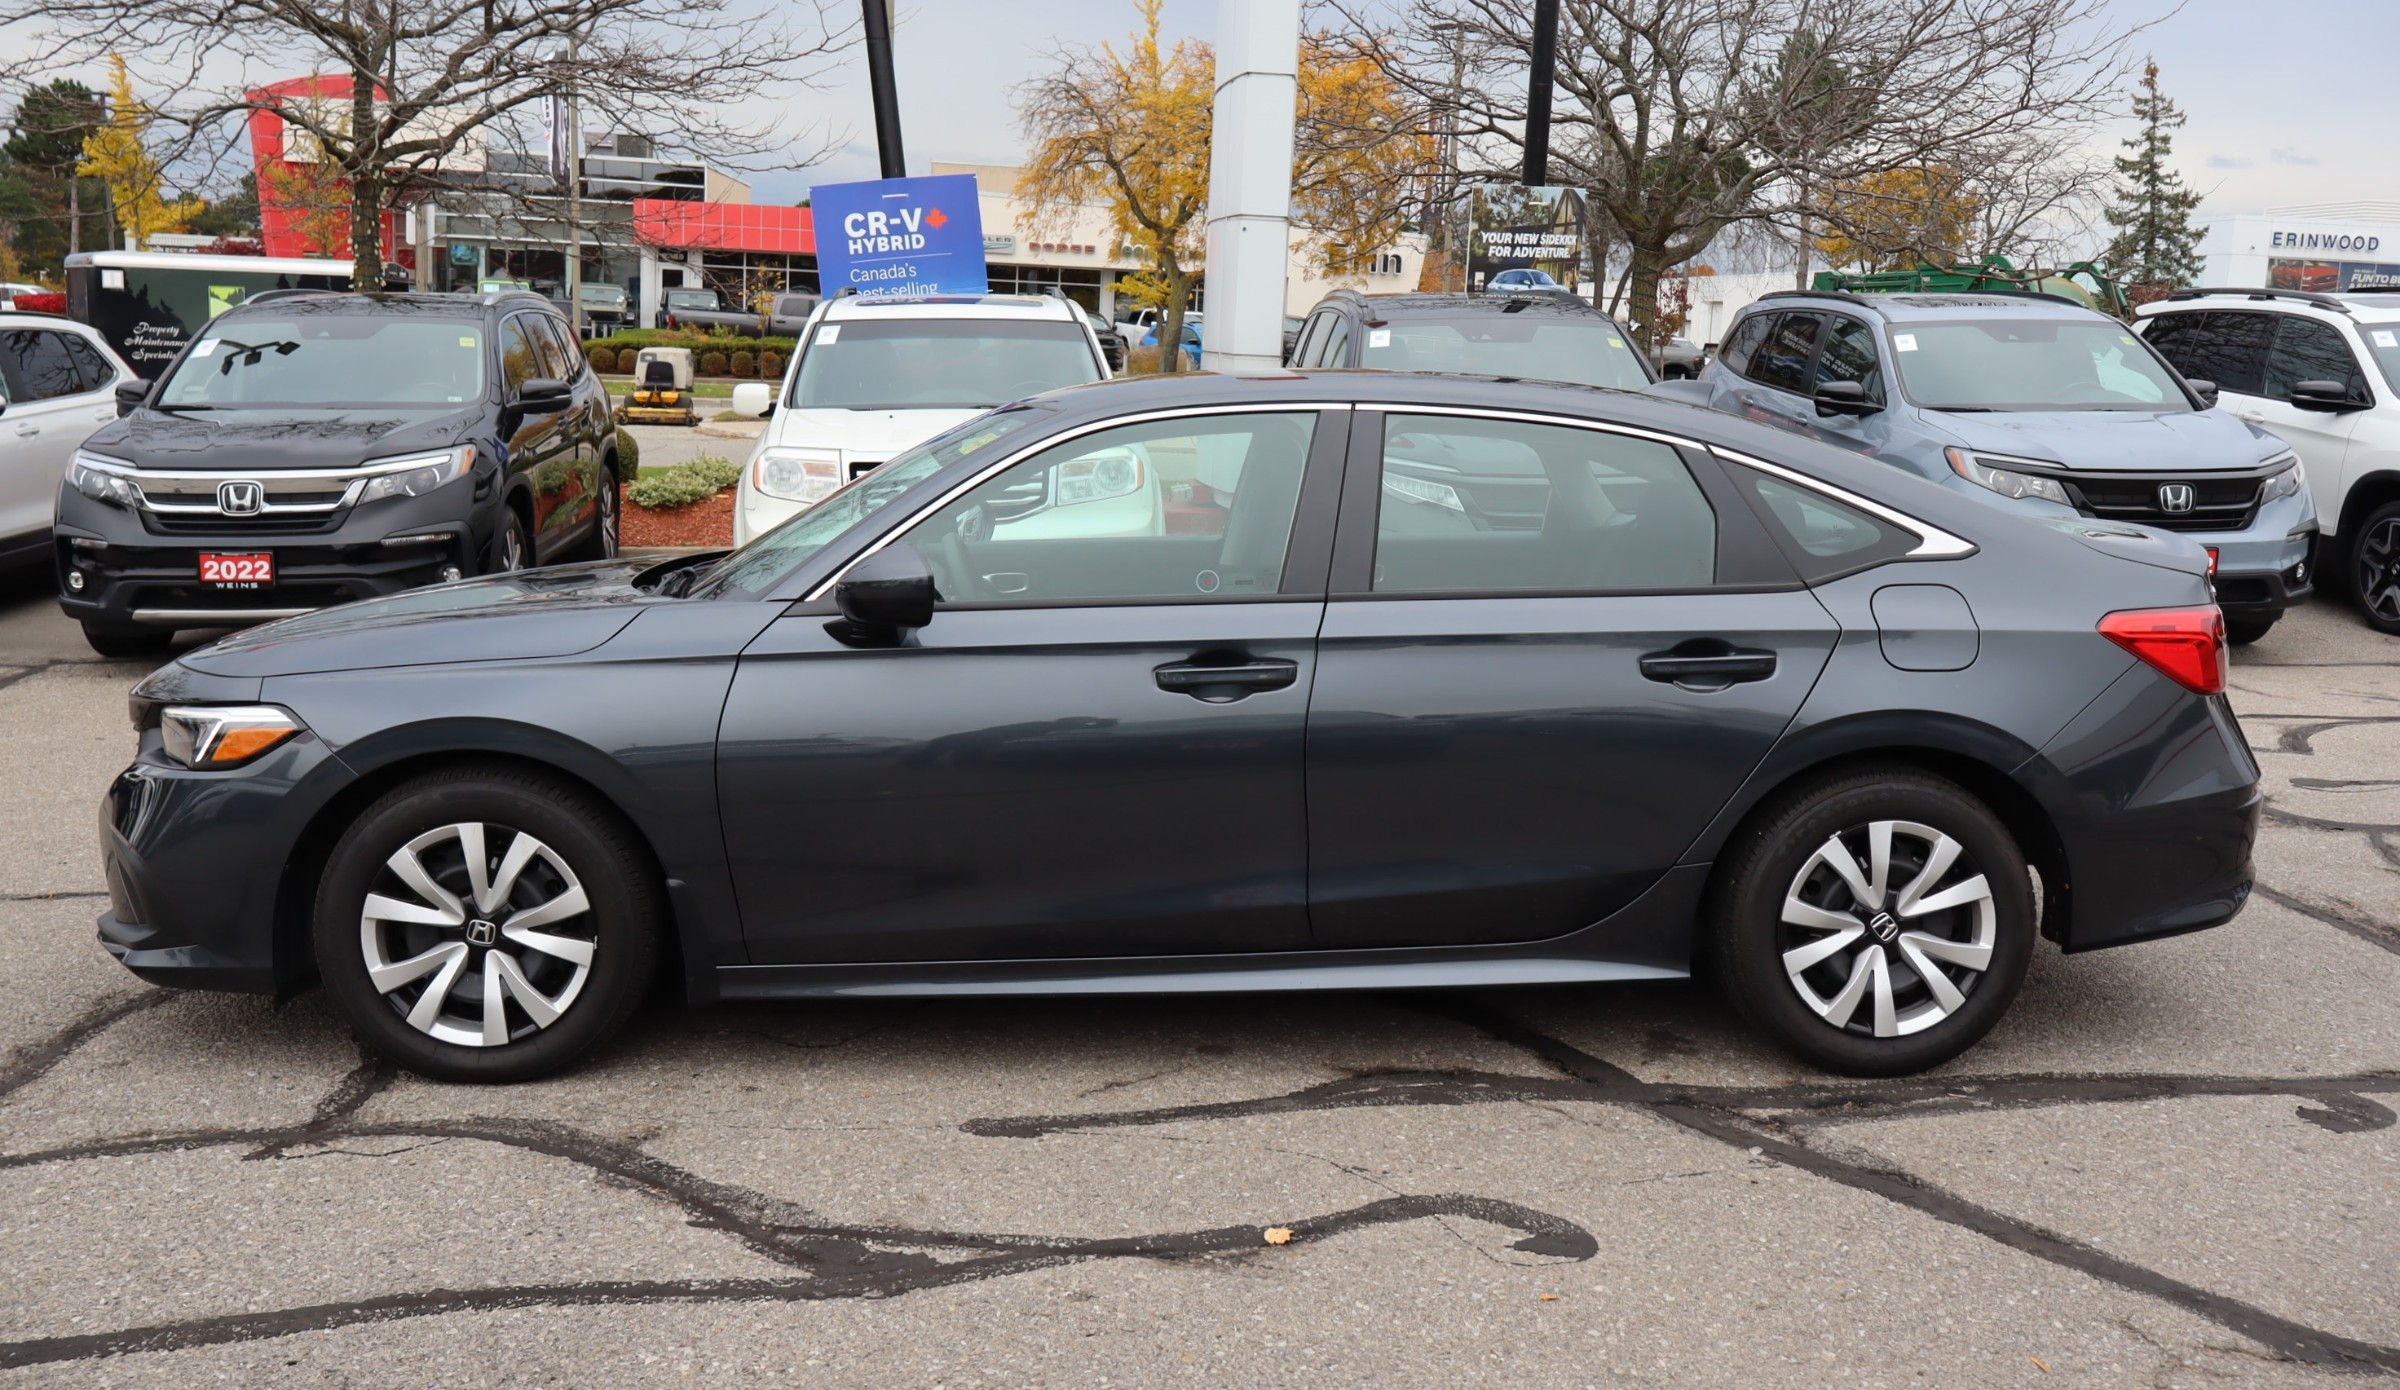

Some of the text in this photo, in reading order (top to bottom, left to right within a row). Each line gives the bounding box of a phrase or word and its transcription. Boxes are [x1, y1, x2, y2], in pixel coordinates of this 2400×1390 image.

[844, 207, 922, 238] CR-V
[848, 234, 925, 255] HYBRID
[1481, 232, 1577, 246] YOUR NEW SIDEKICK
[2272, 232, 2380, 251] ERINWOOD
[1488, 246, 1570, 259] FOR ADVENTURE.
[850, 263, 917, 282] Canada's
[2351, 273, 2374, 283] FUN
[2375, 274, 2389, 284] TO
[133, 321, 180, 337] Property
[203, 560, 271, 580] 2022
[216, 581, 259, 589] WEINS
